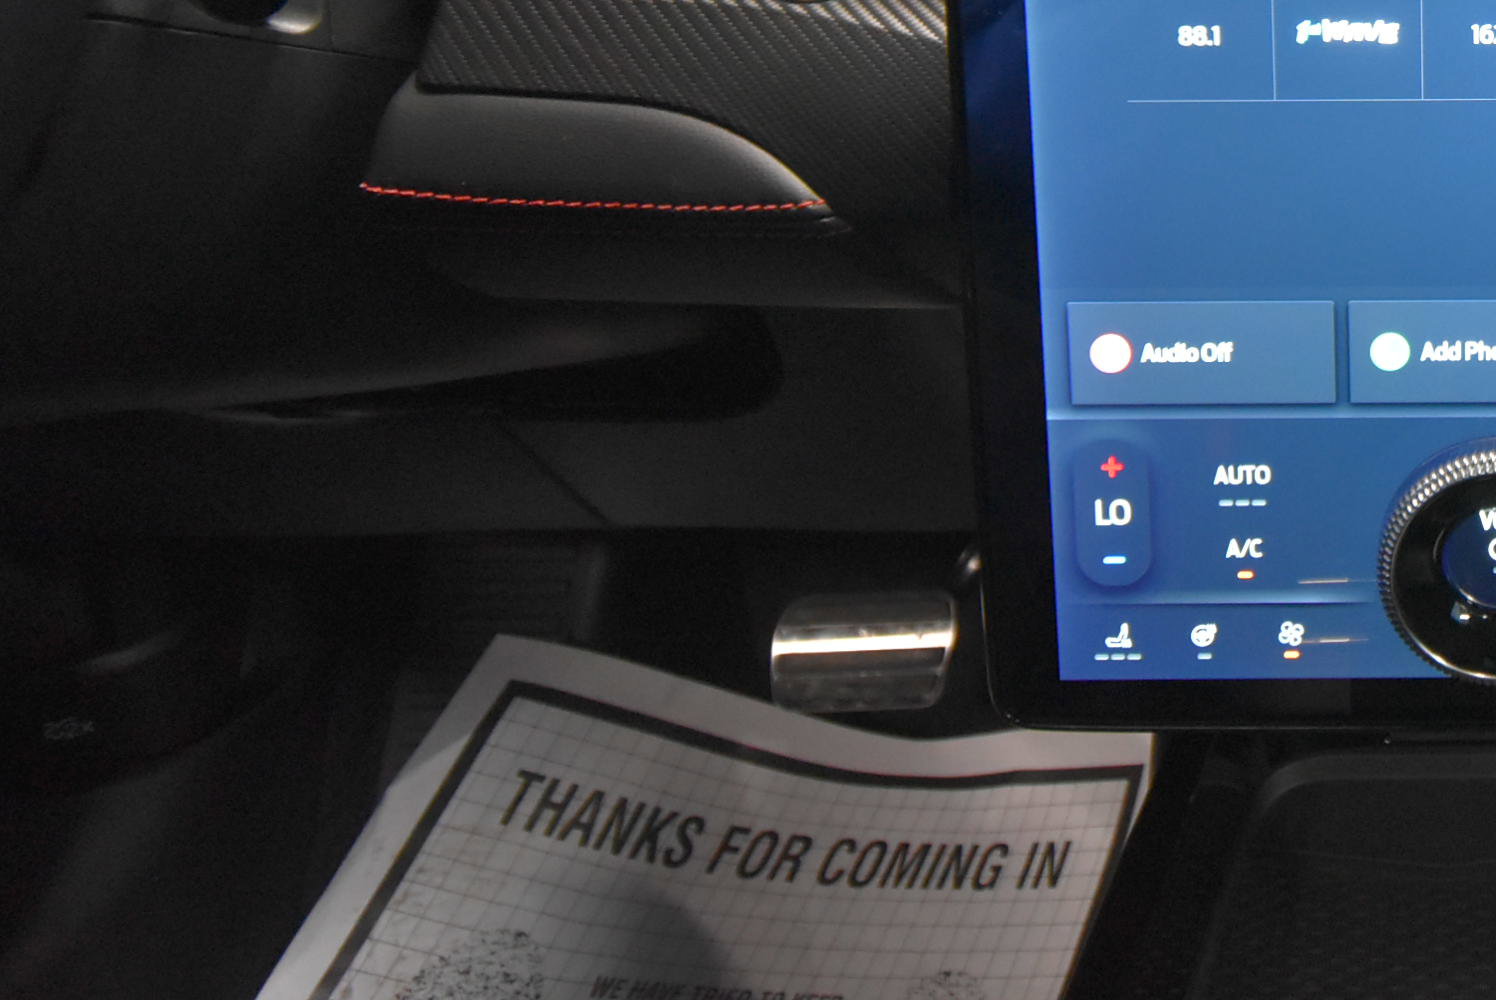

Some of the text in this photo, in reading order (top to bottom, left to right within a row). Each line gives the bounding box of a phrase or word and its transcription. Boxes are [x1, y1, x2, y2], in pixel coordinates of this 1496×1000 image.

[1177, 24, 1221, 47] 88.1
[1140, 341, 1234, 363] Audio Off
[1420, 341, 1462, 362] Add
[1213, 465, 1272, 485] AUTO
[1094, 500, 1133, 526] LO
[1225, 538, 1264, 559] A/C
[500, 769, 1072, 891] THANKS FOR COMING IN
[589, 974, 628, 999] WE
[626, 978, 687, 1000] HAVE
